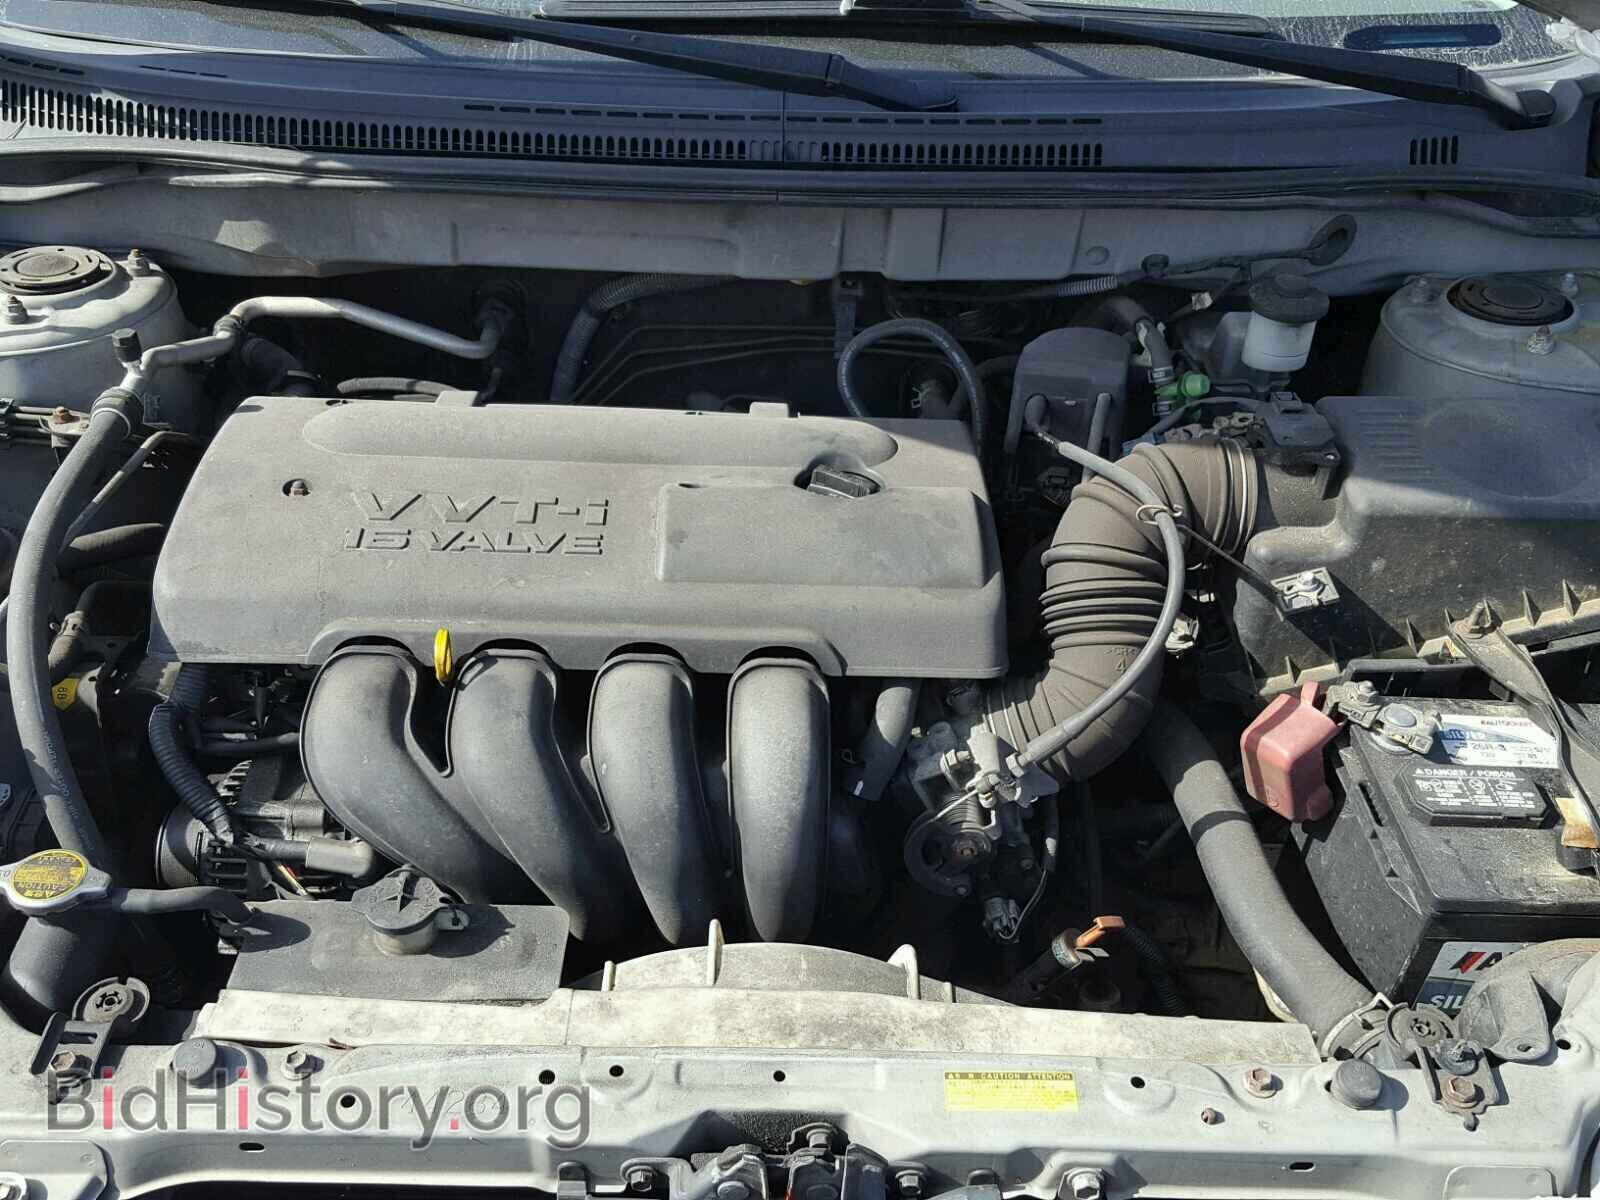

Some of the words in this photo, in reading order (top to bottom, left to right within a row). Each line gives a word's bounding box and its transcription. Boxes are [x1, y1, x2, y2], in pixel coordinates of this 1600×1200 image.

[345, 527, 412, 551] 16
[420, 529, 604, 556] VALVE
[980, 1072, 1020, 1080] CAUTION
[1026, 1072, 1073, 1081] ATTENTION
